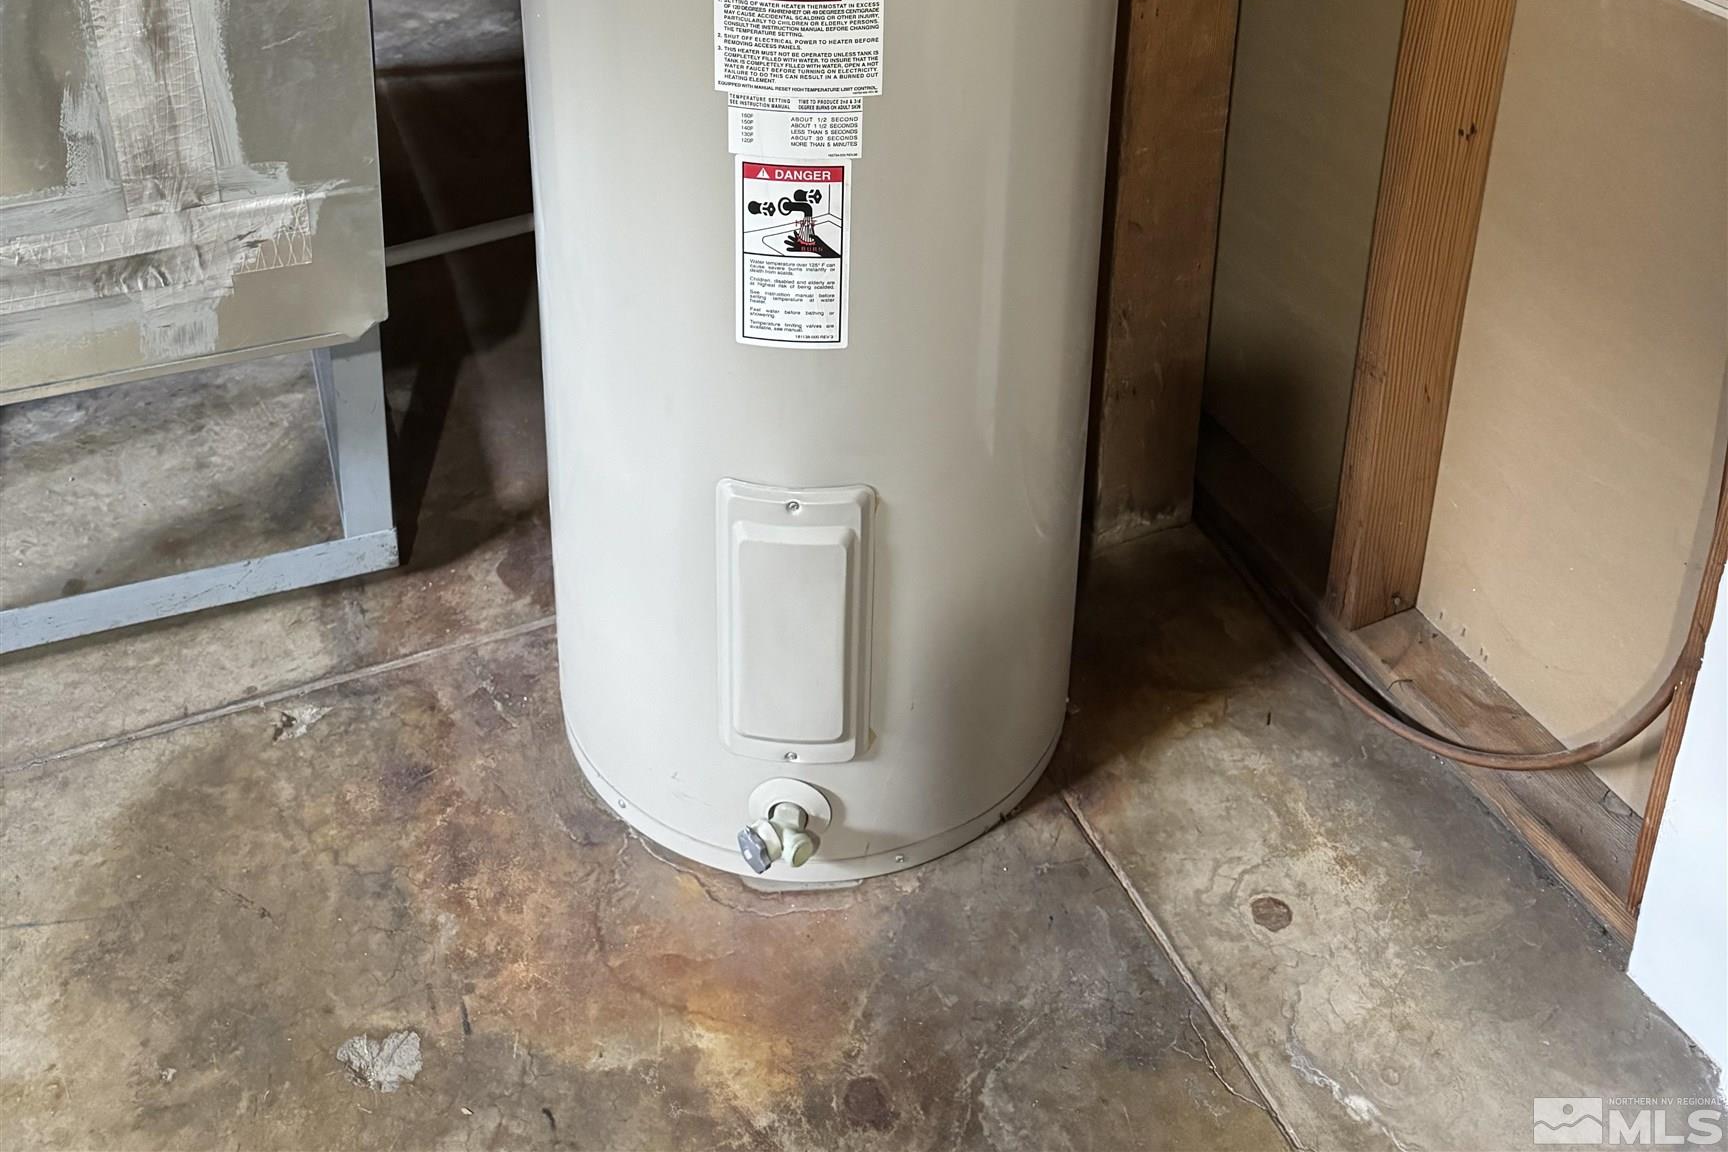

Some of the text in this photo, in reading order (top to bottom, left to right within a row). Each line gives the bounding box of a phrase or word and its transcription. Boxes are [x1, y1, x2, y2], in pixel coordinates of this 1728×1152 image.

[724, 15, 766, 23] PARTICULARLY
[736, 28, 776, 36] TEMPERATURE
[730, 93, 766, 102] TEMPERATURE
[775, 169, 831, 180] DANGER
